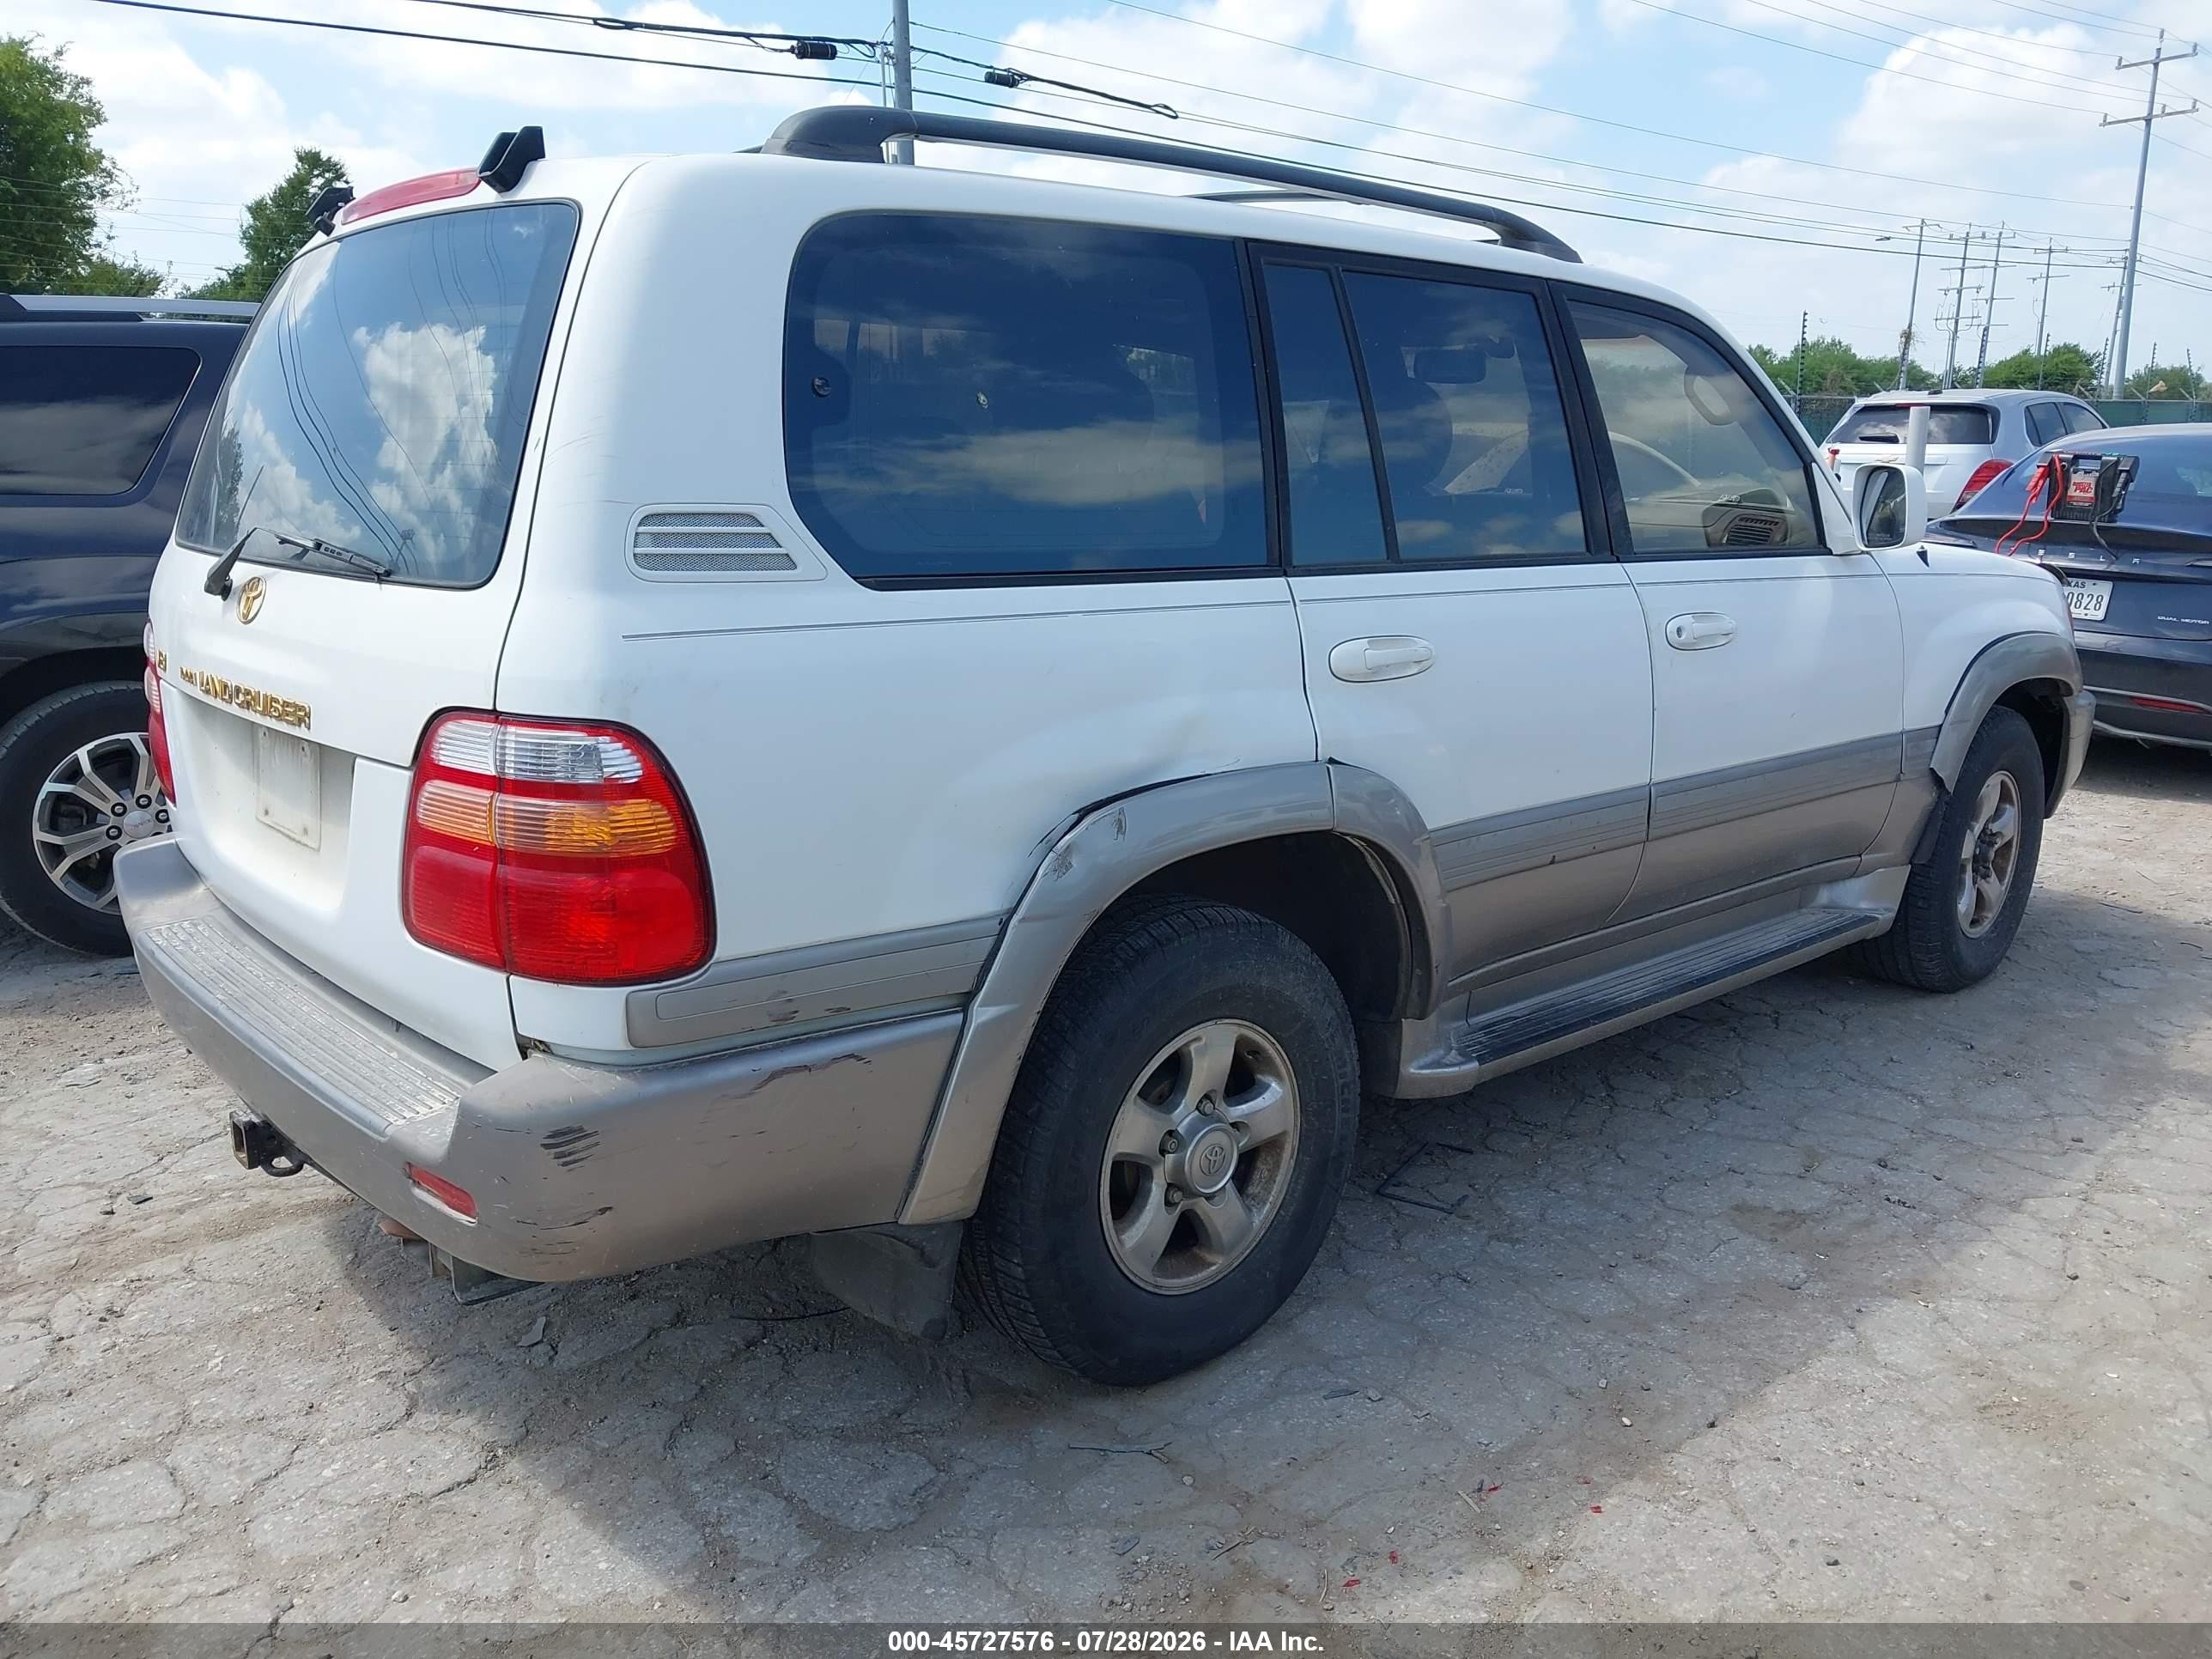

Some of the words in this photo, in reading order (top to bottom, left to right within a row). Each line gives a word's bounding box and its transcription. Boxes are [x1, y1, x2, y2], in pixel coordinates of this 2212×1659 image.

[2074, 485, 2094, 494] PAC
[2062, 580, 2087, 589] XAS
[198, 671, 233, 704] LAND
[233, 684, 311, 730] CRUISER
